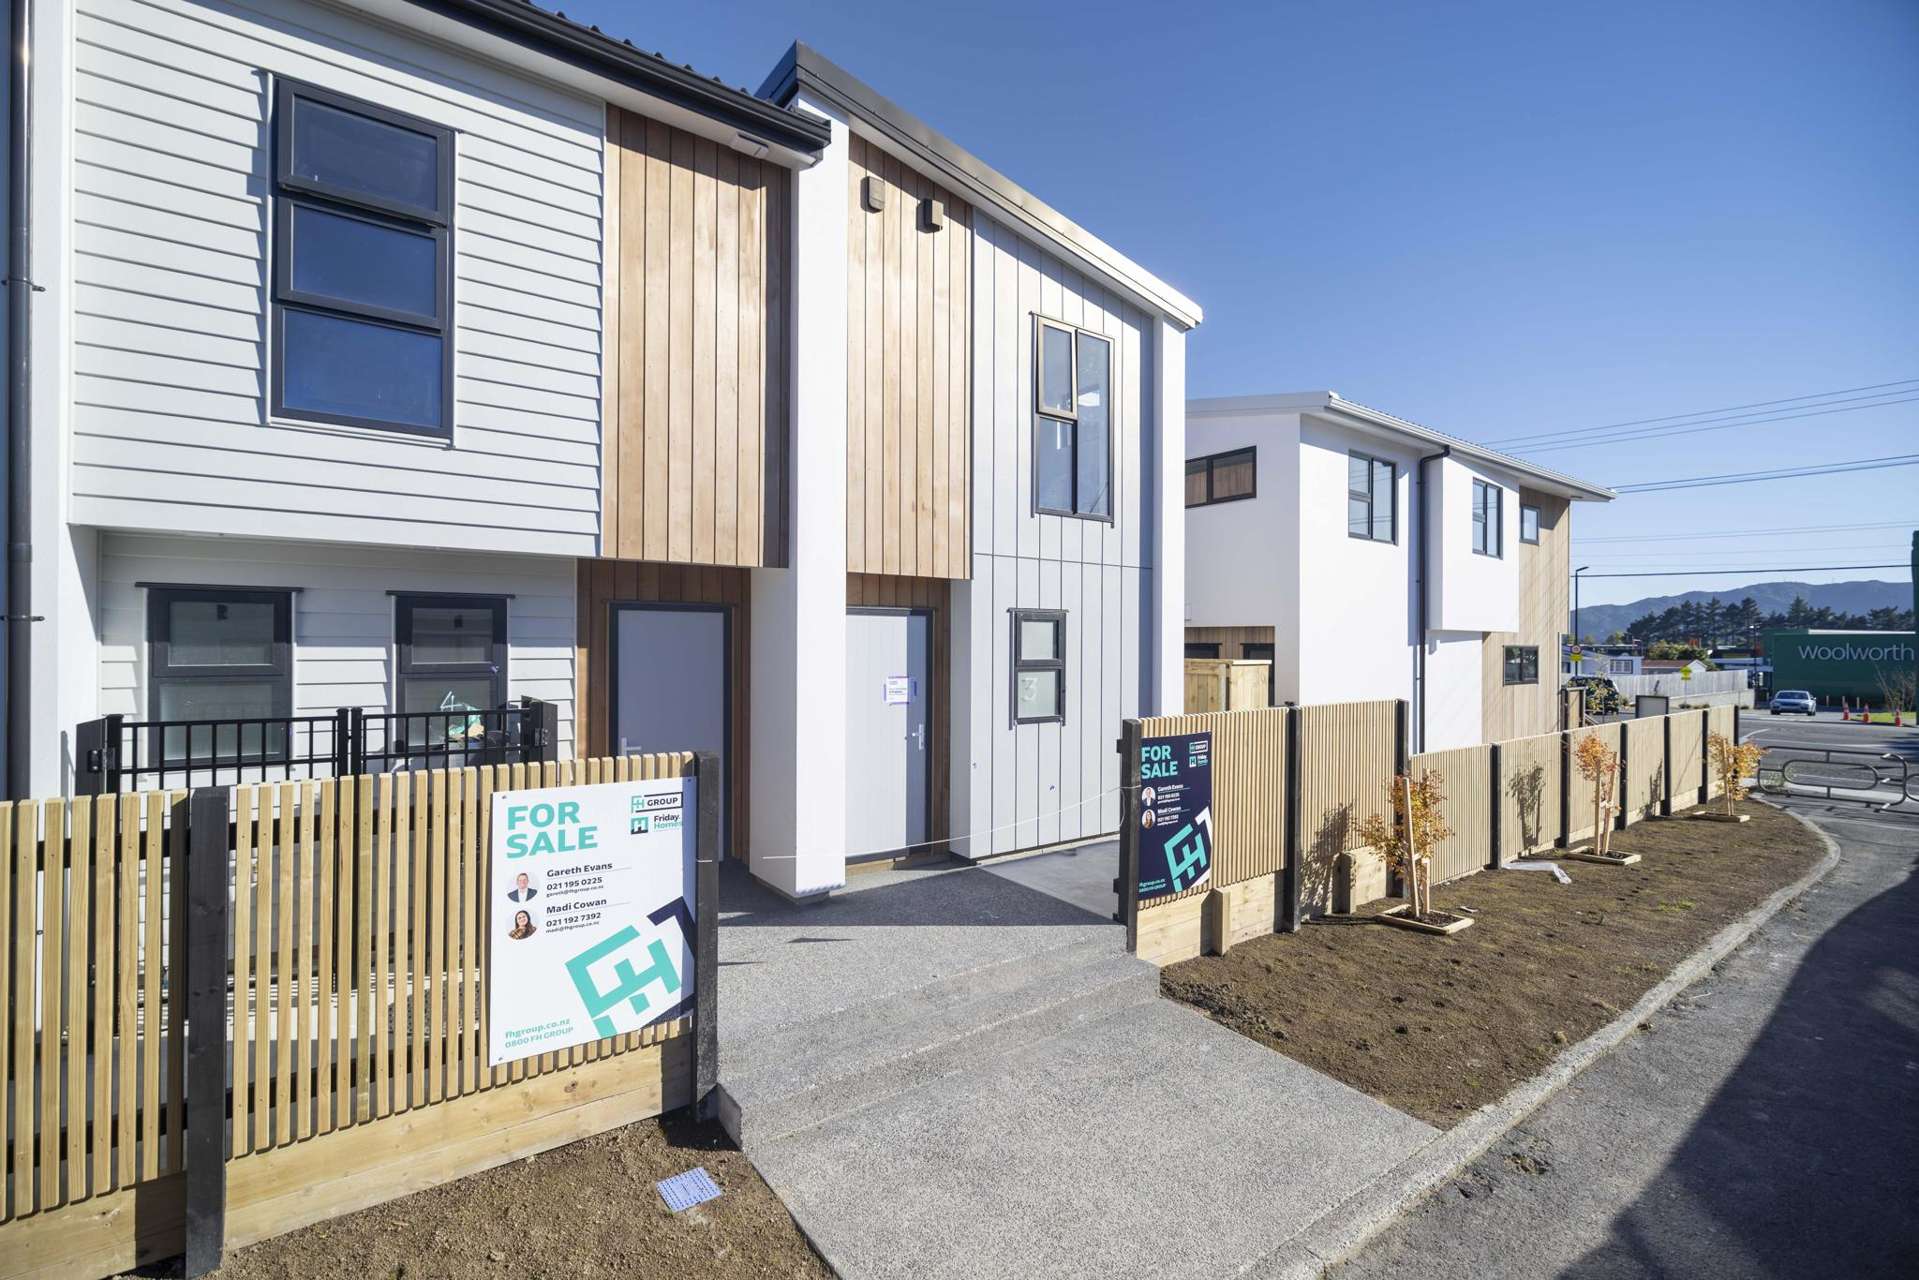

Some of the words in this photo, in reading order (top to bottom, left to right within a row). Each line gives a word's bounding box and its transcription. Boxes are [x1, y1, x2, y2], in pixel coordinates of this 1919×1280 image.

[1141, 745, 1171, 762] FOR
[1141, 761, 1178, 779] SALE
[647, 797, 679, 807] GROUP
[507, 801, 581, 831] FOR
[506, 826, 598, 859] SALE
[546, 866, 582, 878] Gareth
[583, 862, 613, 872] Evans
[546, 882, 562, 891] 021
[564, 879, 580, 888] 195
[581, 876, 603, 886] 0225
[546, 903, 572, 914] Madi
[573, 899, 607, 910] Cowan
[546, 918, 562, 927] 021
[564, 916, 579, 924] 192
[580, 912, 601, 921] 7392
